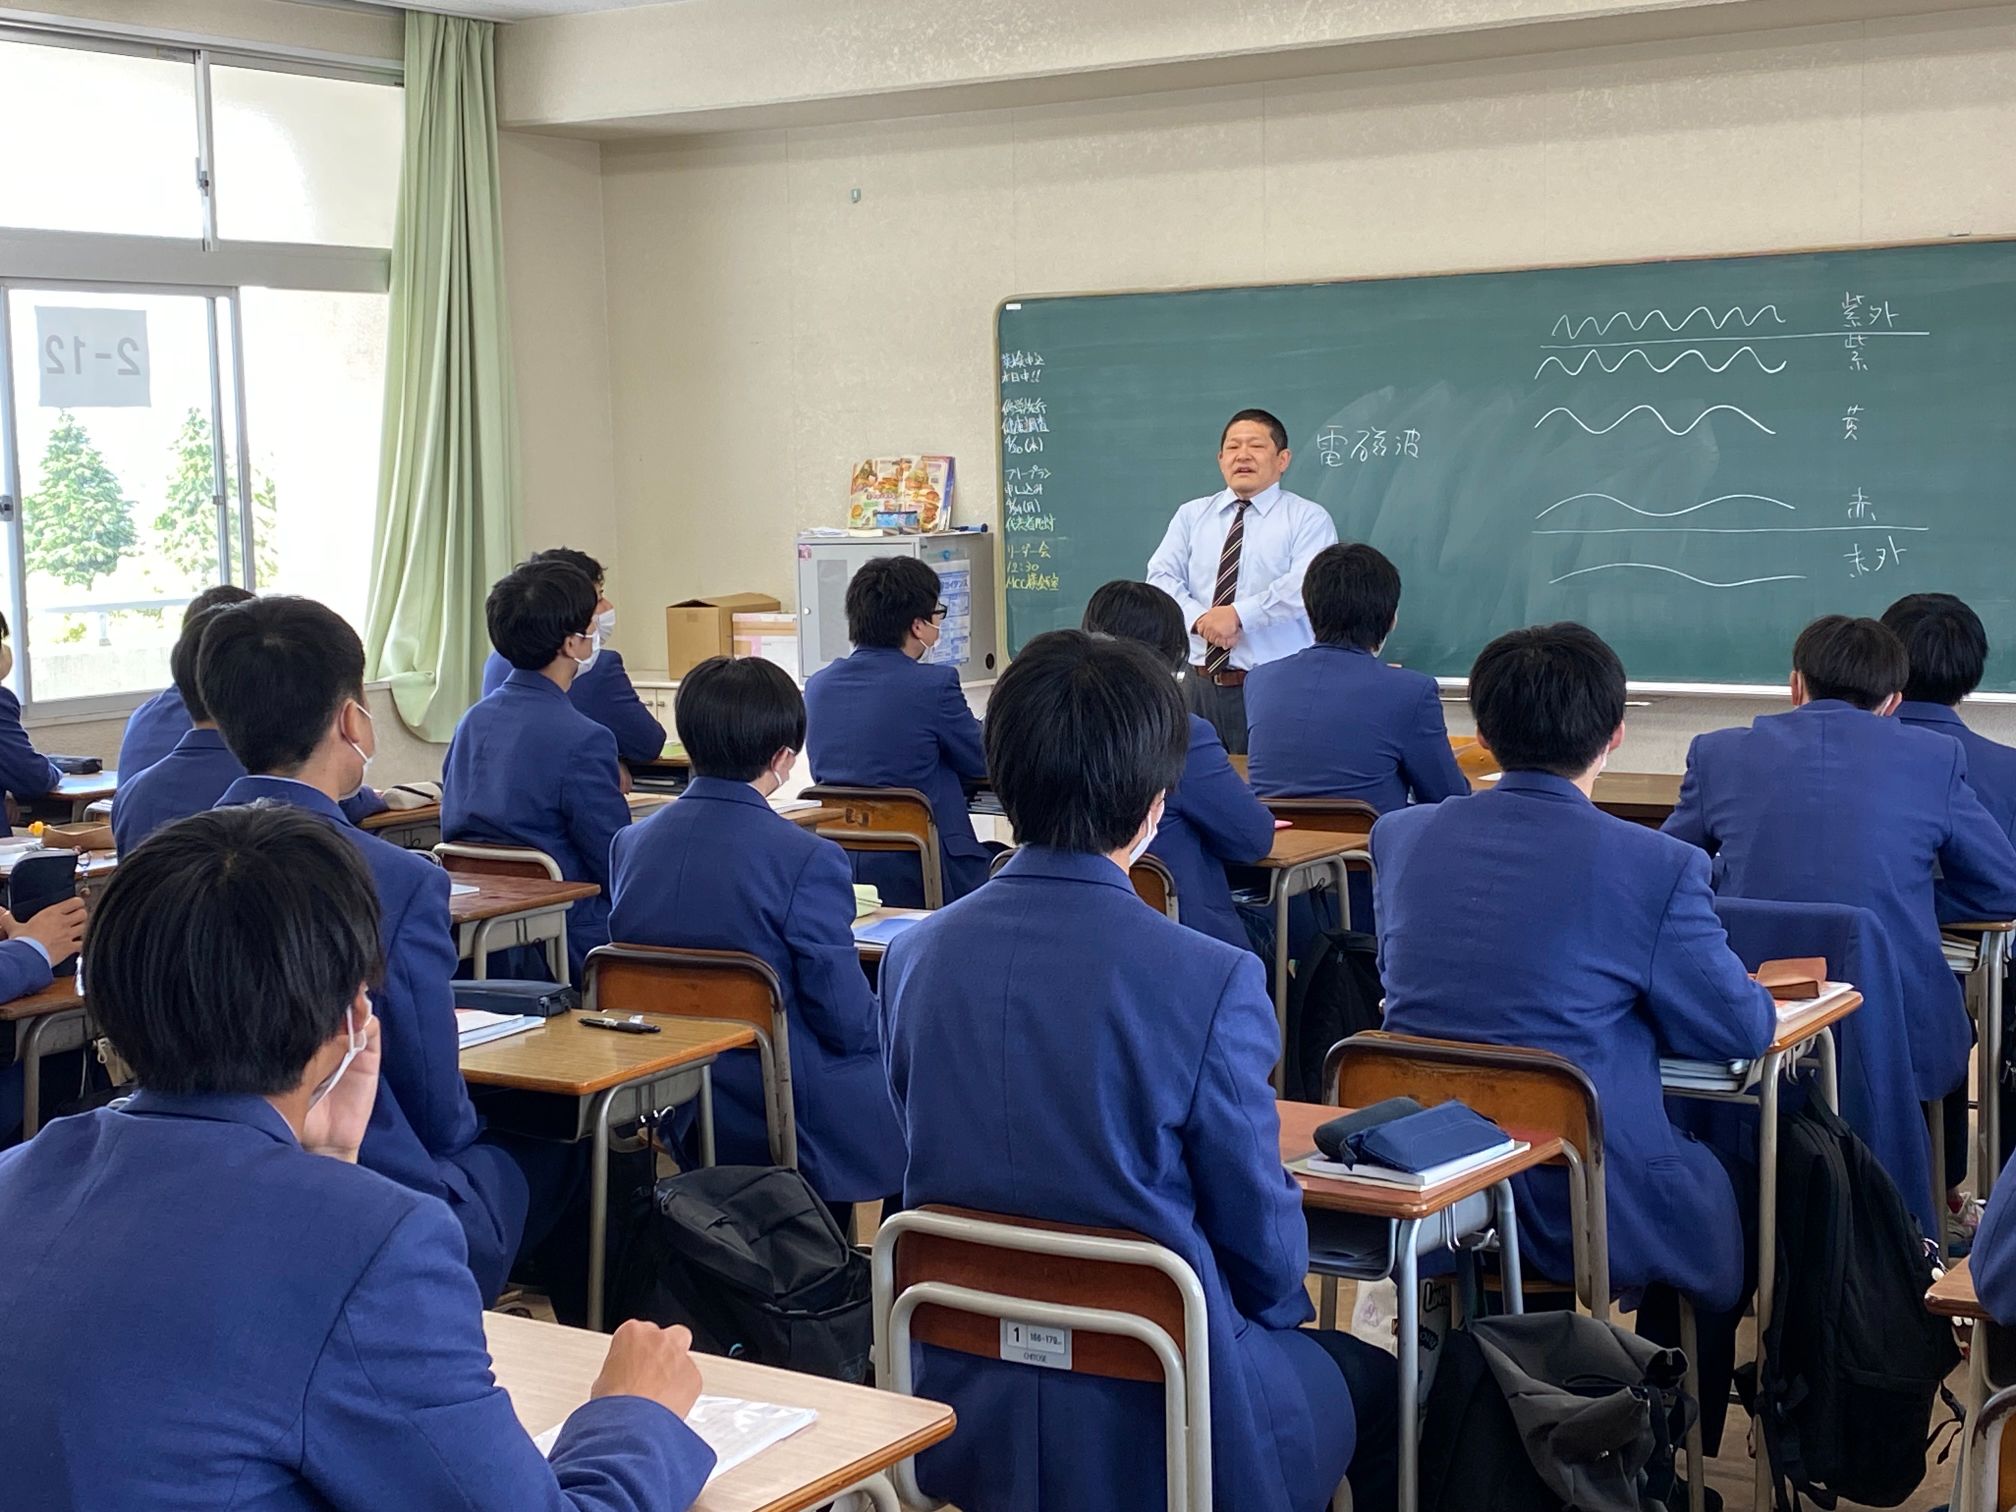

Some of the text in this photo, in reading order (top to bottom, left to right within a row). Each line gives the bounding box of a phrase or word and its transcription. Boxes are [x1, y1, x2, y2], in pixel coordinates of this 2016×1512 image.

[1841, 290, 1900, 329] 紫外
[1844, 333, 1869, 371] 紫
[1841, 403, 1865, 441] 黄
[1316, 425, 1421, 468] 電磁波
[1847, 486, 1877, 521] 赤
[1007, 541, 1051, 559] リーダー会
[1007, 562, 1040, 573] 12:30
[1013, 1327, 1020, 1343] 1
